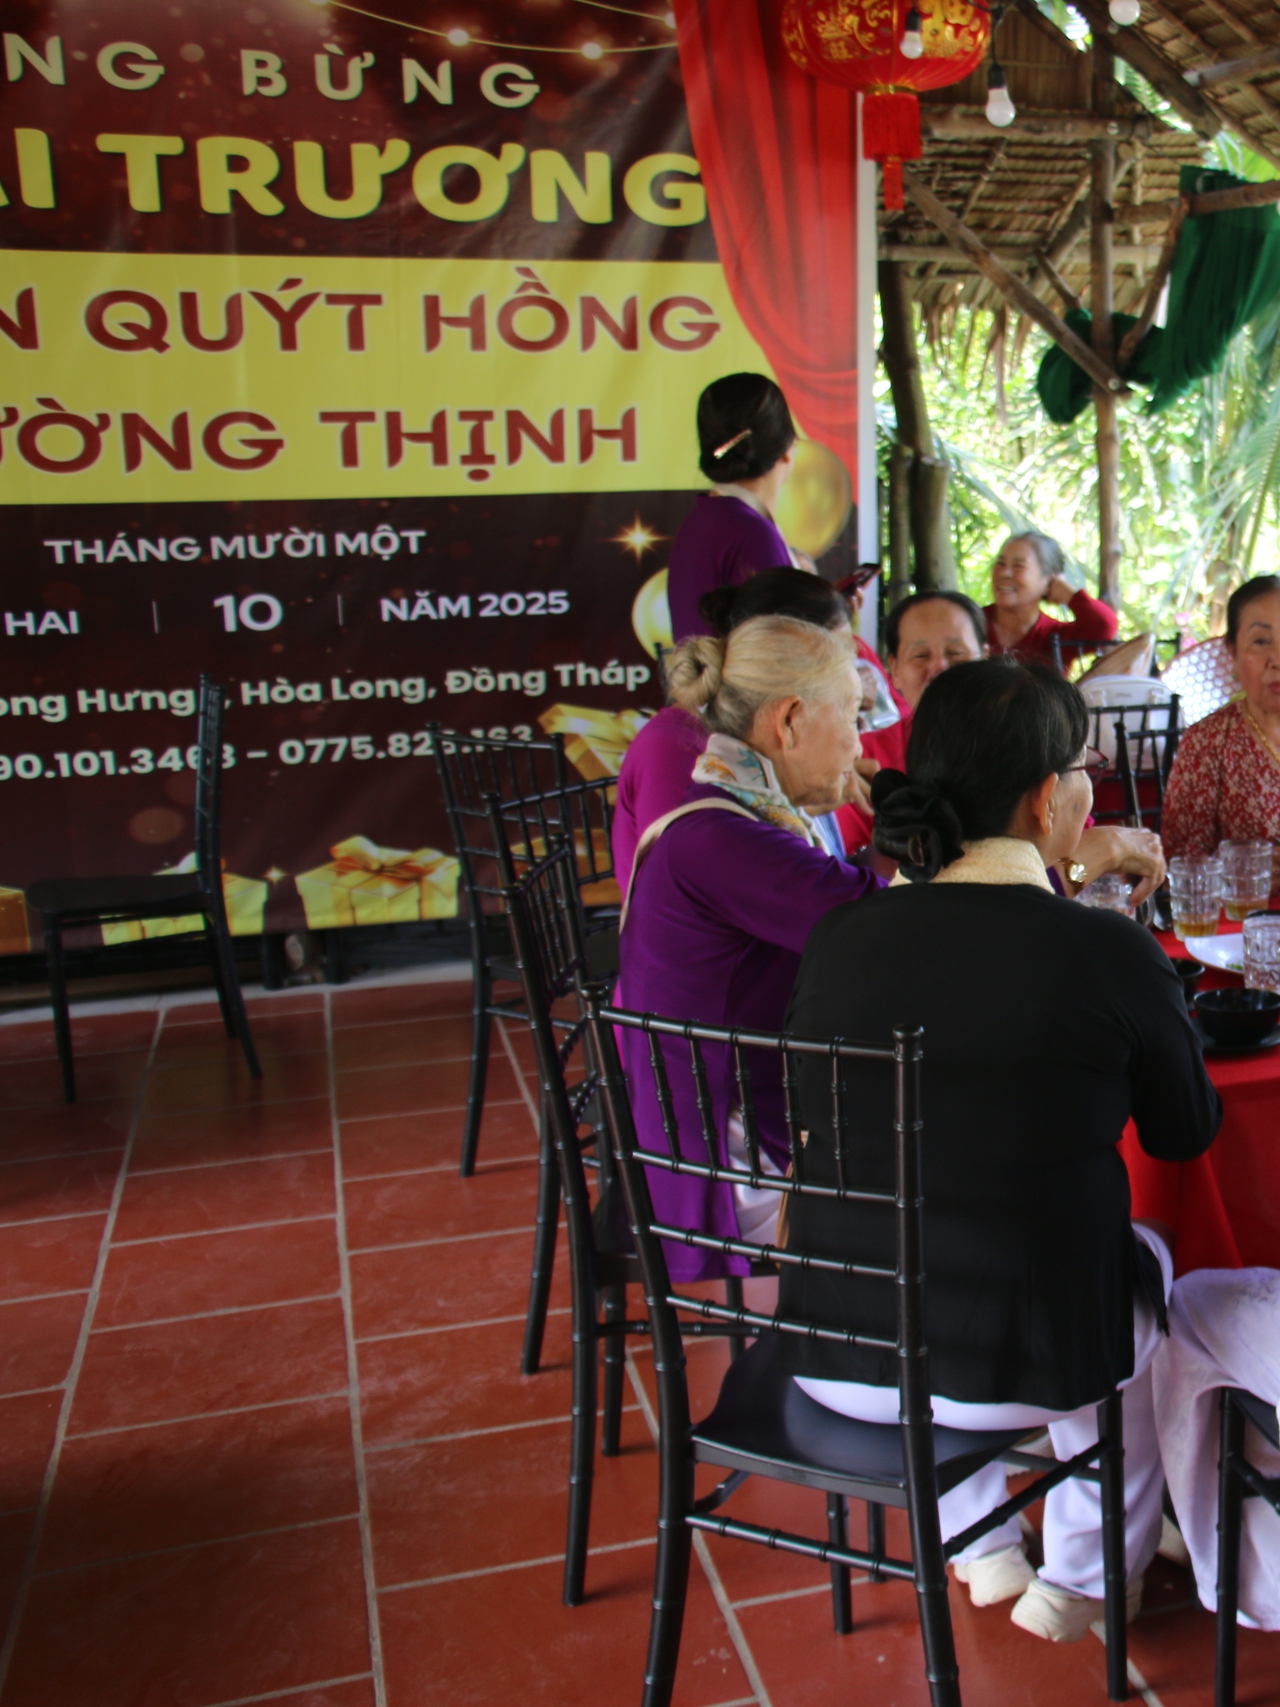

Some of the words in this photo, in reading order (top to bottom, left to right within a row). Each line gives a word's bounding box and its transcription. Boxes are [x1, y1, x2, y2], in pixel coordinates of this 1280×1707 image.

[4, 33, 165, 91] NG
[240, 43, 540, 108] BỪNG
[0, 127, 55, 209] I
[95, 133, 707, 227] TRƯƠNG
[85, 278, 383, 354] QUÝT
[423, 266, 722, 353] HỒNG
[0, 397, 285, 474] ỜNG
[319, 406, 637, 482] THỊNH
[43, 532, 202, 565] THÁNG
[210, 526, 327, 560] MƯỜI
[334, 524, 427, 561] MỘT
[4, 610, 80, 636] HAI
[213, 593, 283, 633] 10
[380, 590, 471, 622] NĂM
[478, 590, 570, 618] 2025
[77, 688, 197, 717] Hưng
[240, 677, 323, 706] Hòa
[331, 677, 437, 704] Long,
[444, 667, 547, 697] Đồng
[553, 659, 651, 692] Tháp
